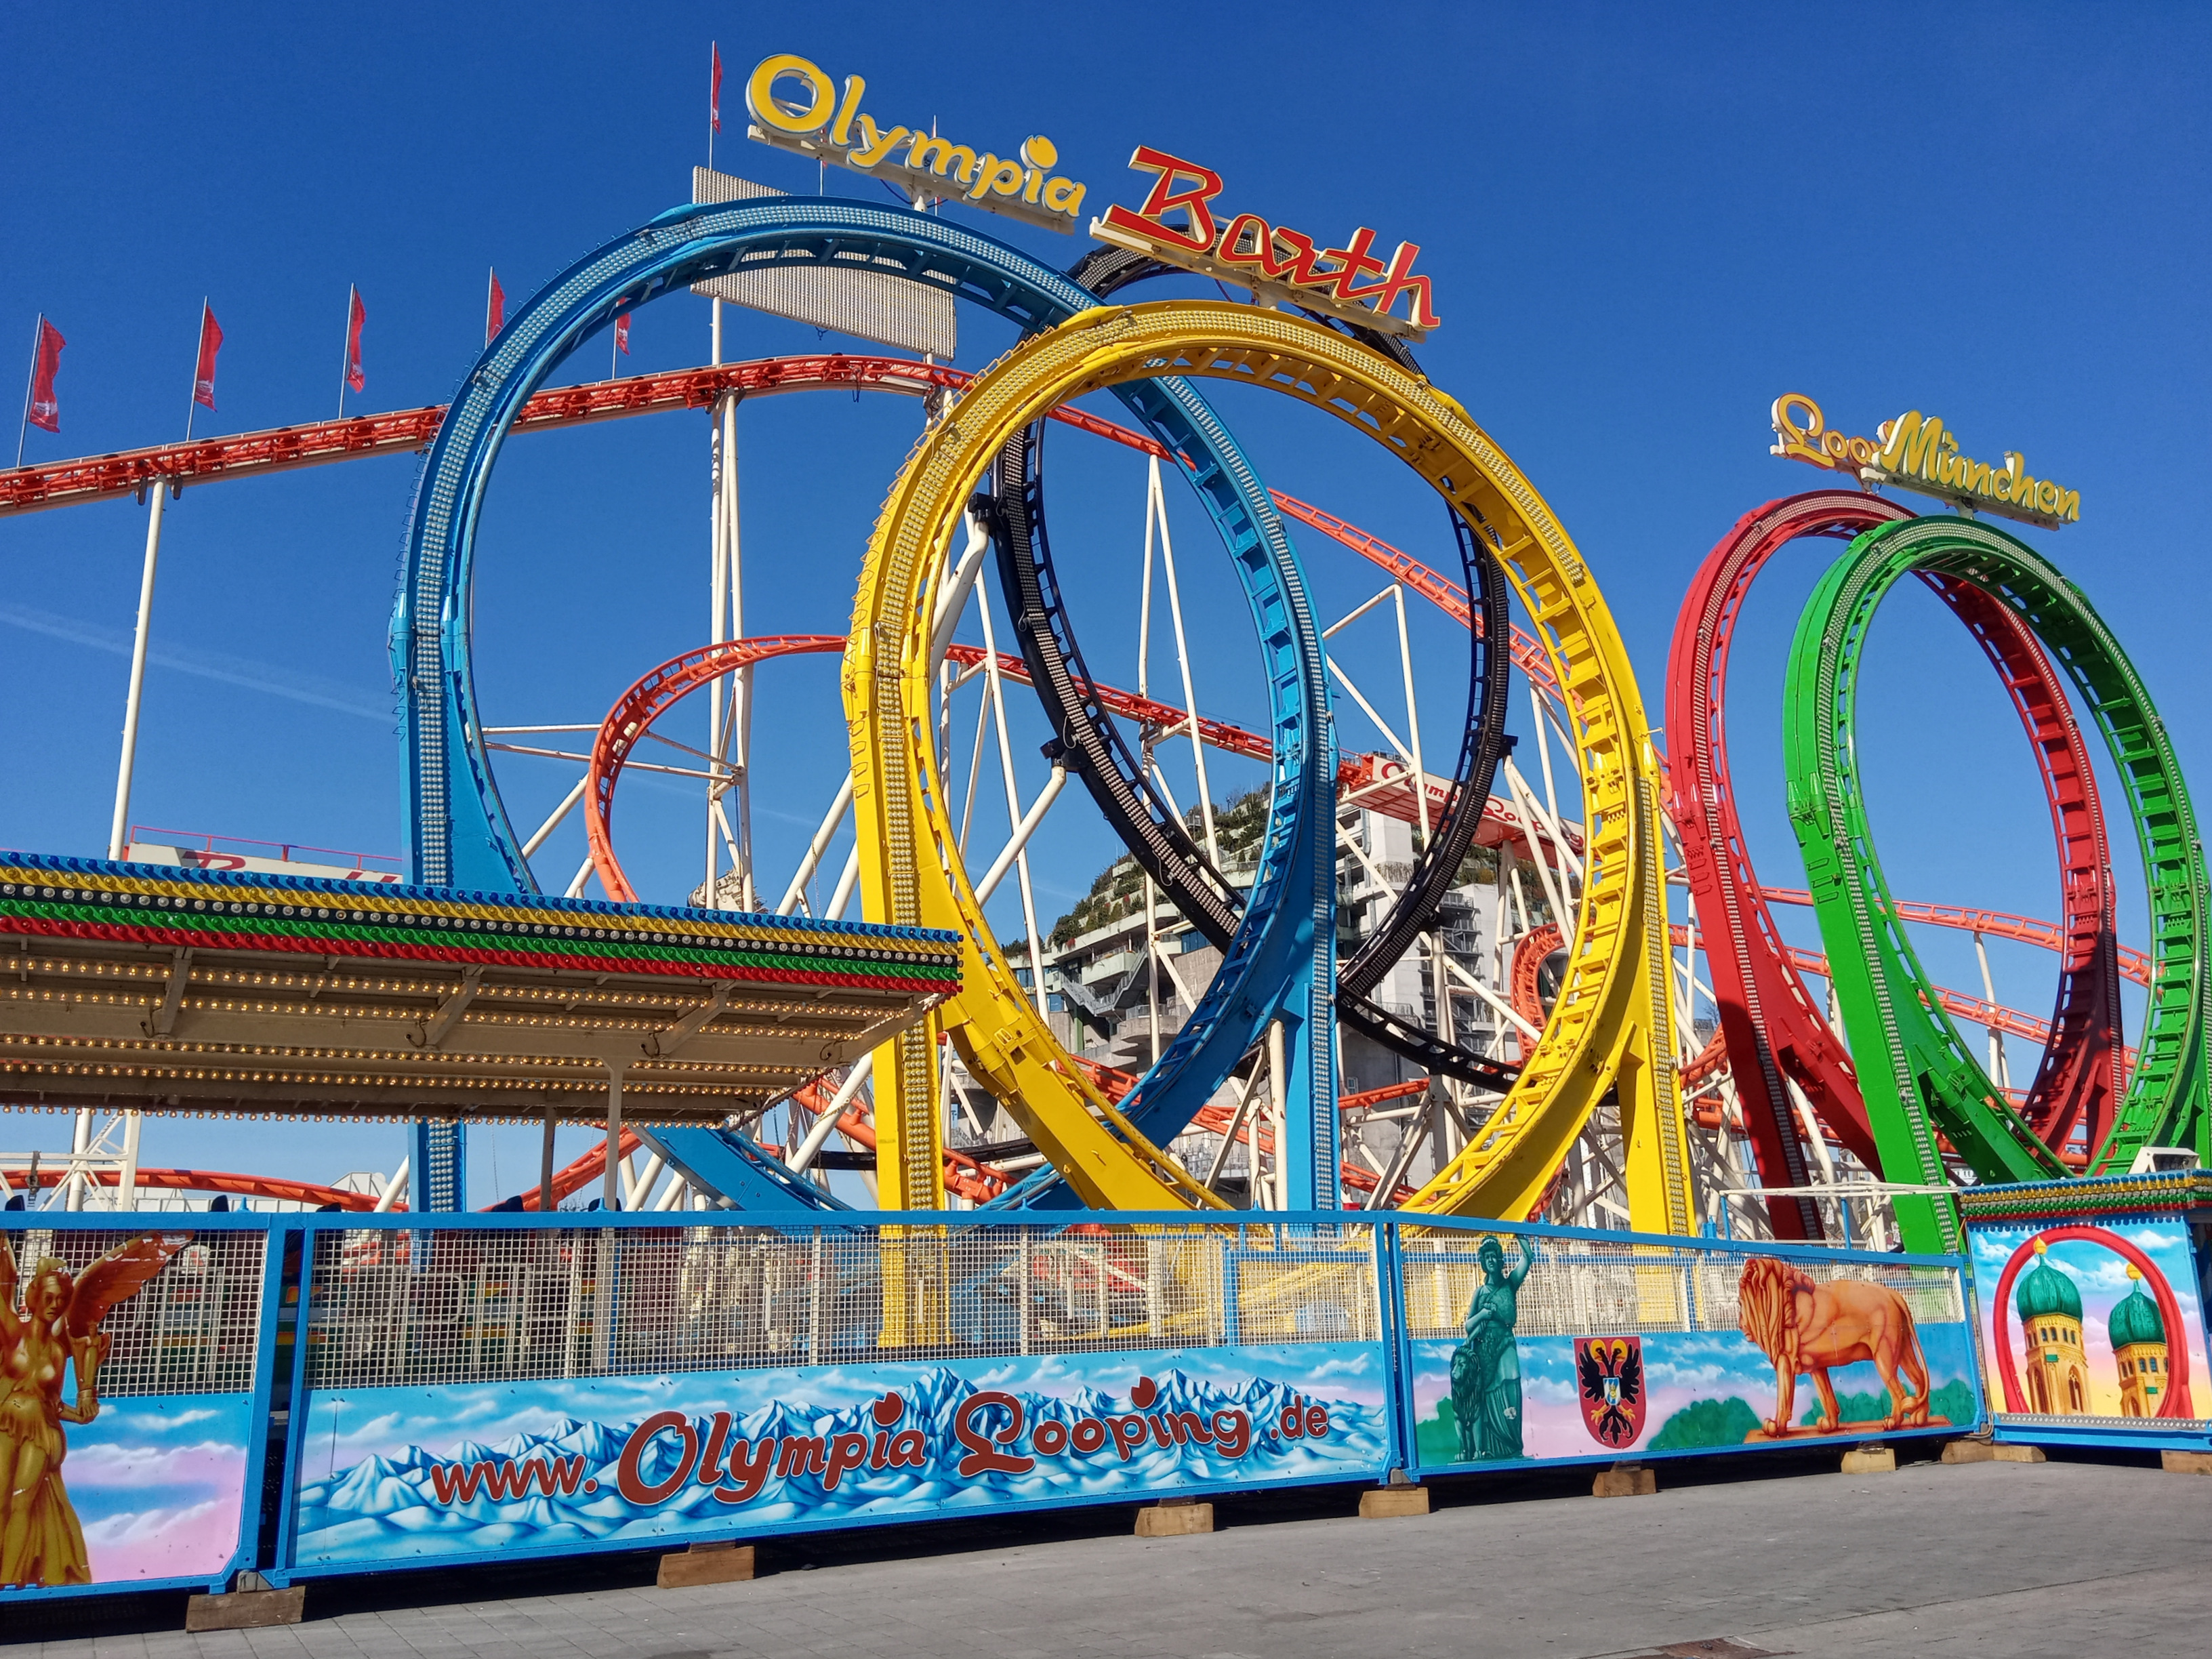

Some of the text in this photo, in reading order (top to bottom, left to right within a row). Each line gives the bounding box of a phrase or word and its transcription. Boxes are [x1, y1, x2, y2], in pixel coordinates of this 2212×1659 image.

[746, 53, 1086, 219] Olympia
[1099, 144, 1440, 330] Barth
[1872, 409, 2081, 522] München
[617, 1391, 926, 1505] Olympia
[955, 1375, 1250, 1478] Looping
